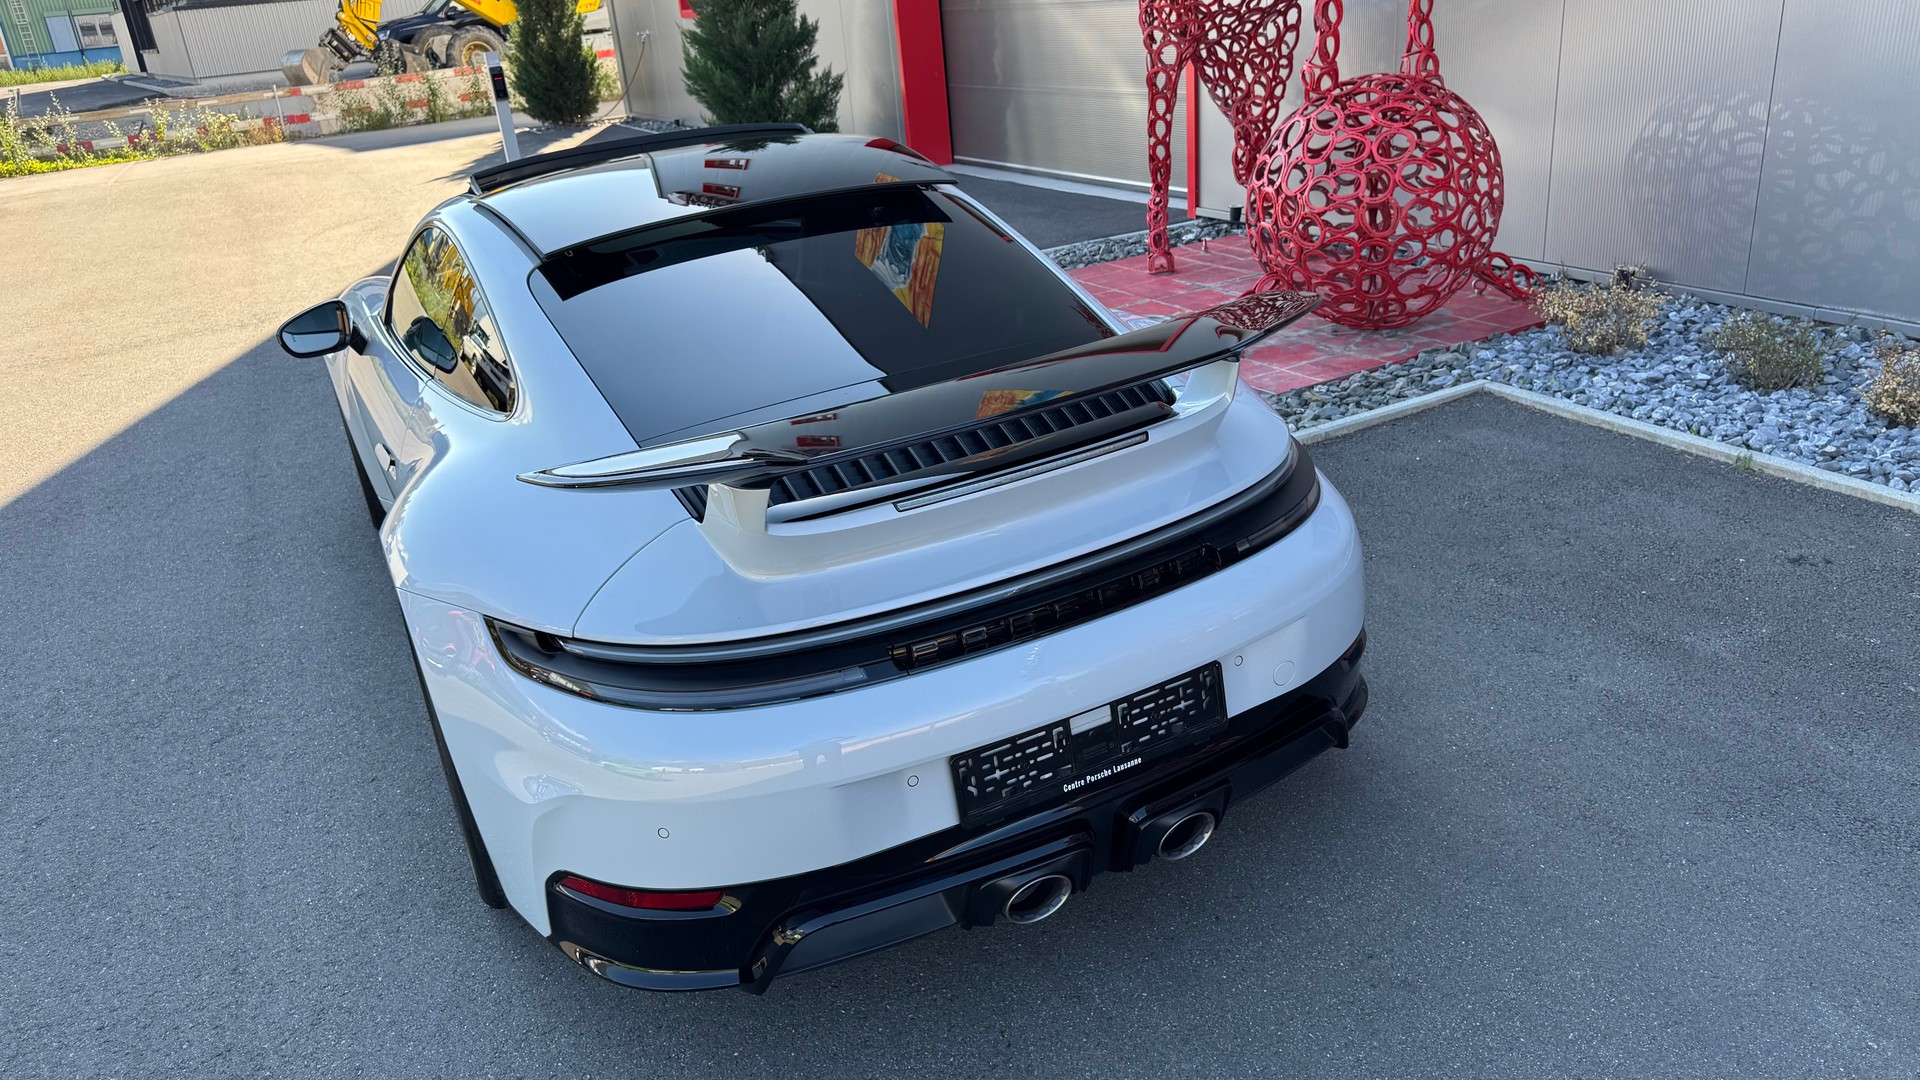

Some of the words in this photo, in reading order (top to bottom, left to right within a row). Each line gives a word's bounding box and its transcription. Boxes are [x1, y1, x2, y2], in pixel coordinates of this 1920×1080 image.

[1063, 779, 1085, 793] Centre
[1086, 768, 1112, 784] Porsche
[1112, 757, 1142, 774] Lausanne
